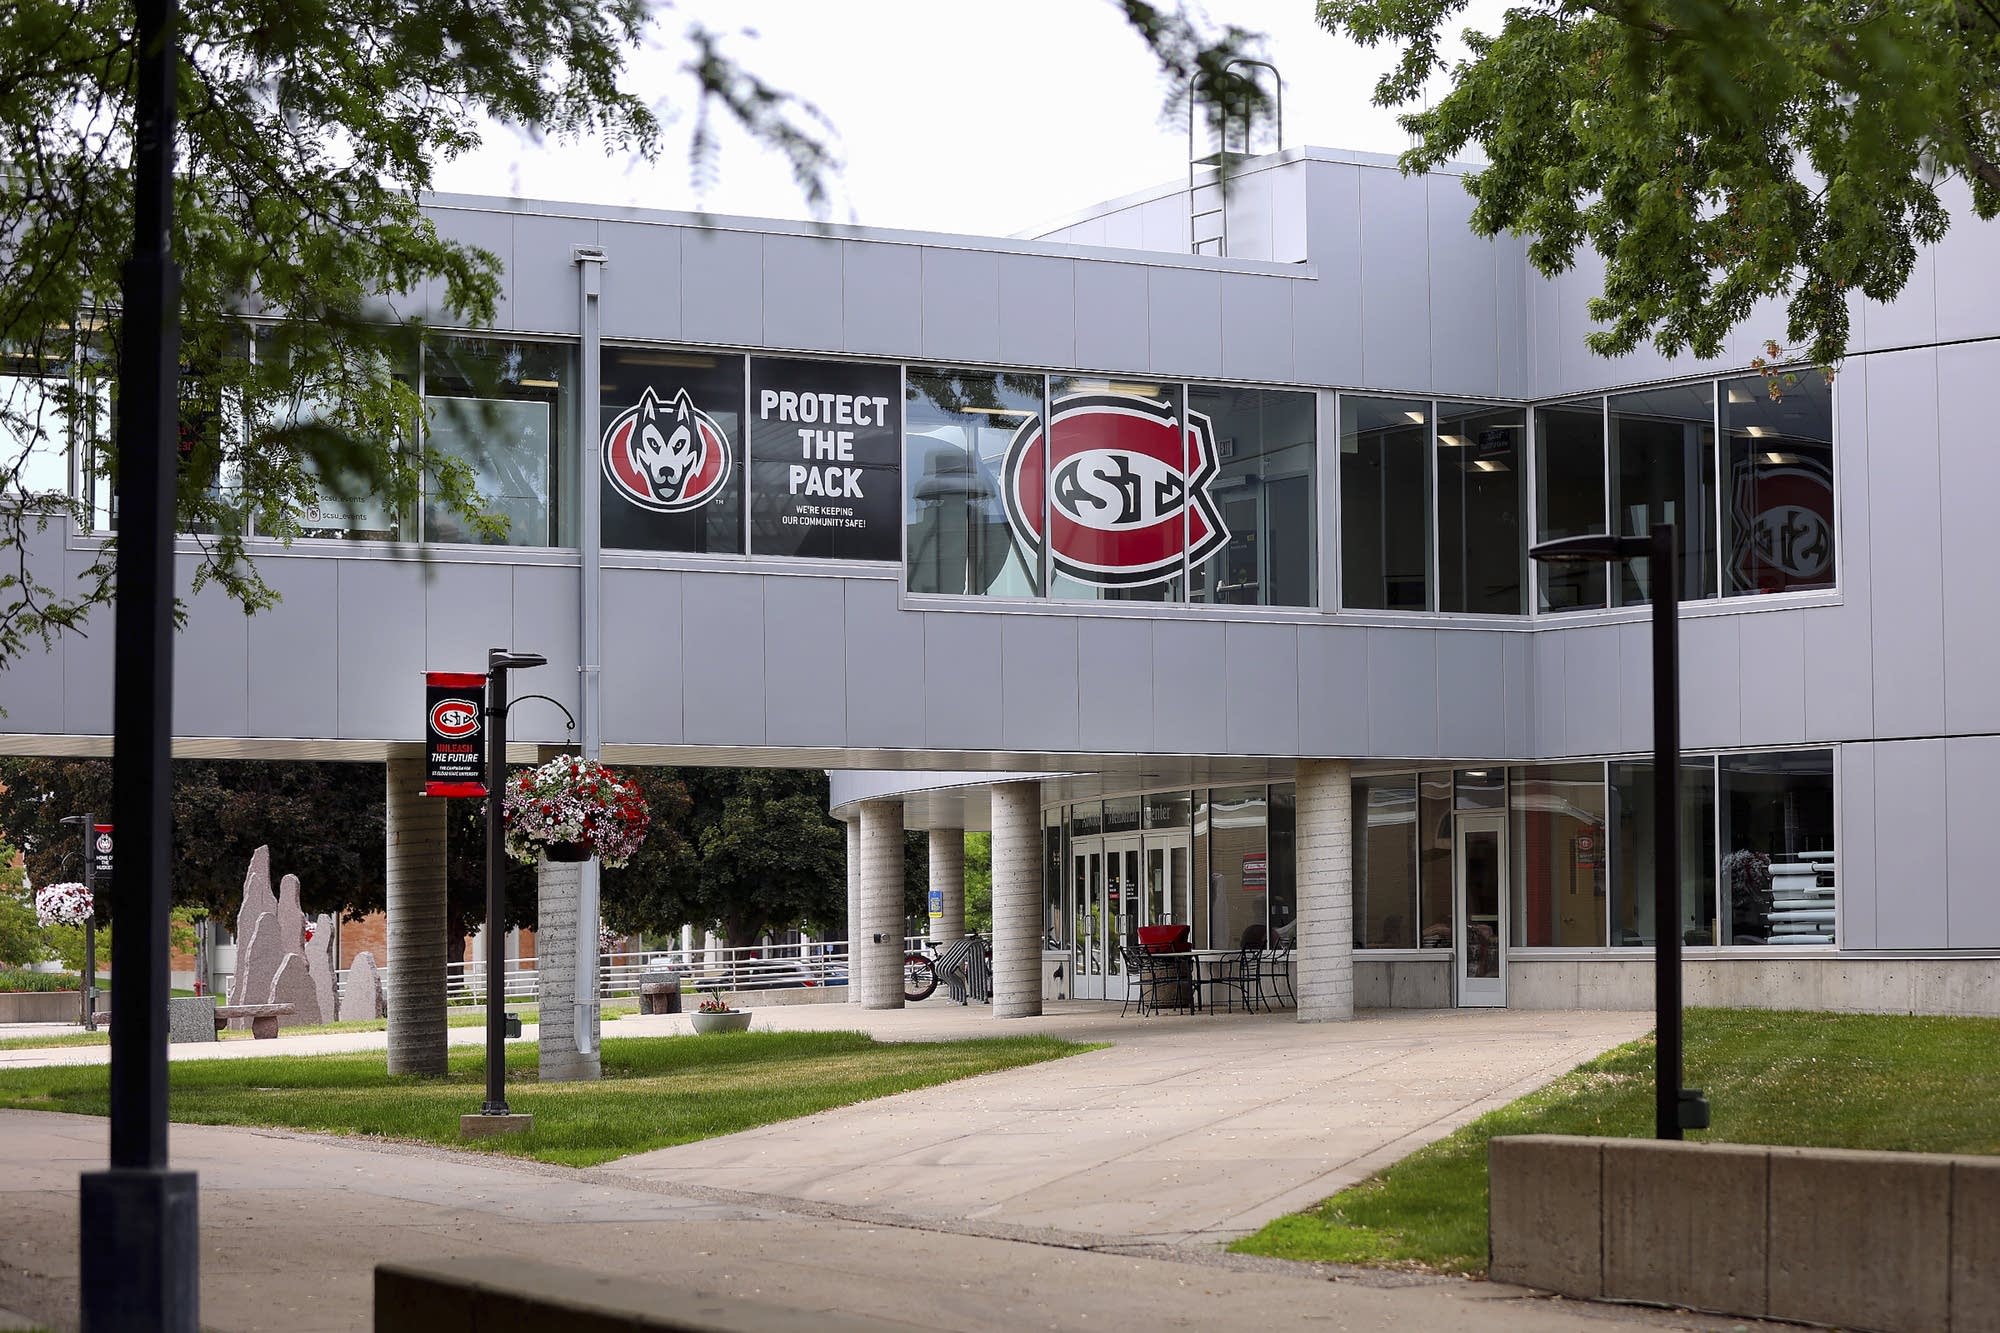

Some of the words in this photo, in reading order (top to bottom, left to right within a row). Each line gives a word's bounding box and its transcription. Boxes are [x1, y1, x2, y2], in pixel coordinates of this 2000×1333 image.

[760, 389, 889, 427] PROTECT
[797, 429, 854, 461] THE
[789, 464, 864, 498] PACK
[796, 505, 820, 515] WE'RE
[820, 506, 853, 517] KEEPING
[782, 515, 798, 525] OUR
[799, 516, 844, 527] COMMUNITY
[844, 518, 866, 528] SAFE!
[436, 743, 473, 752] UNLEASH
[431, 753, 447, 762] THE
[447, 753, 479, 763] FUTURE
